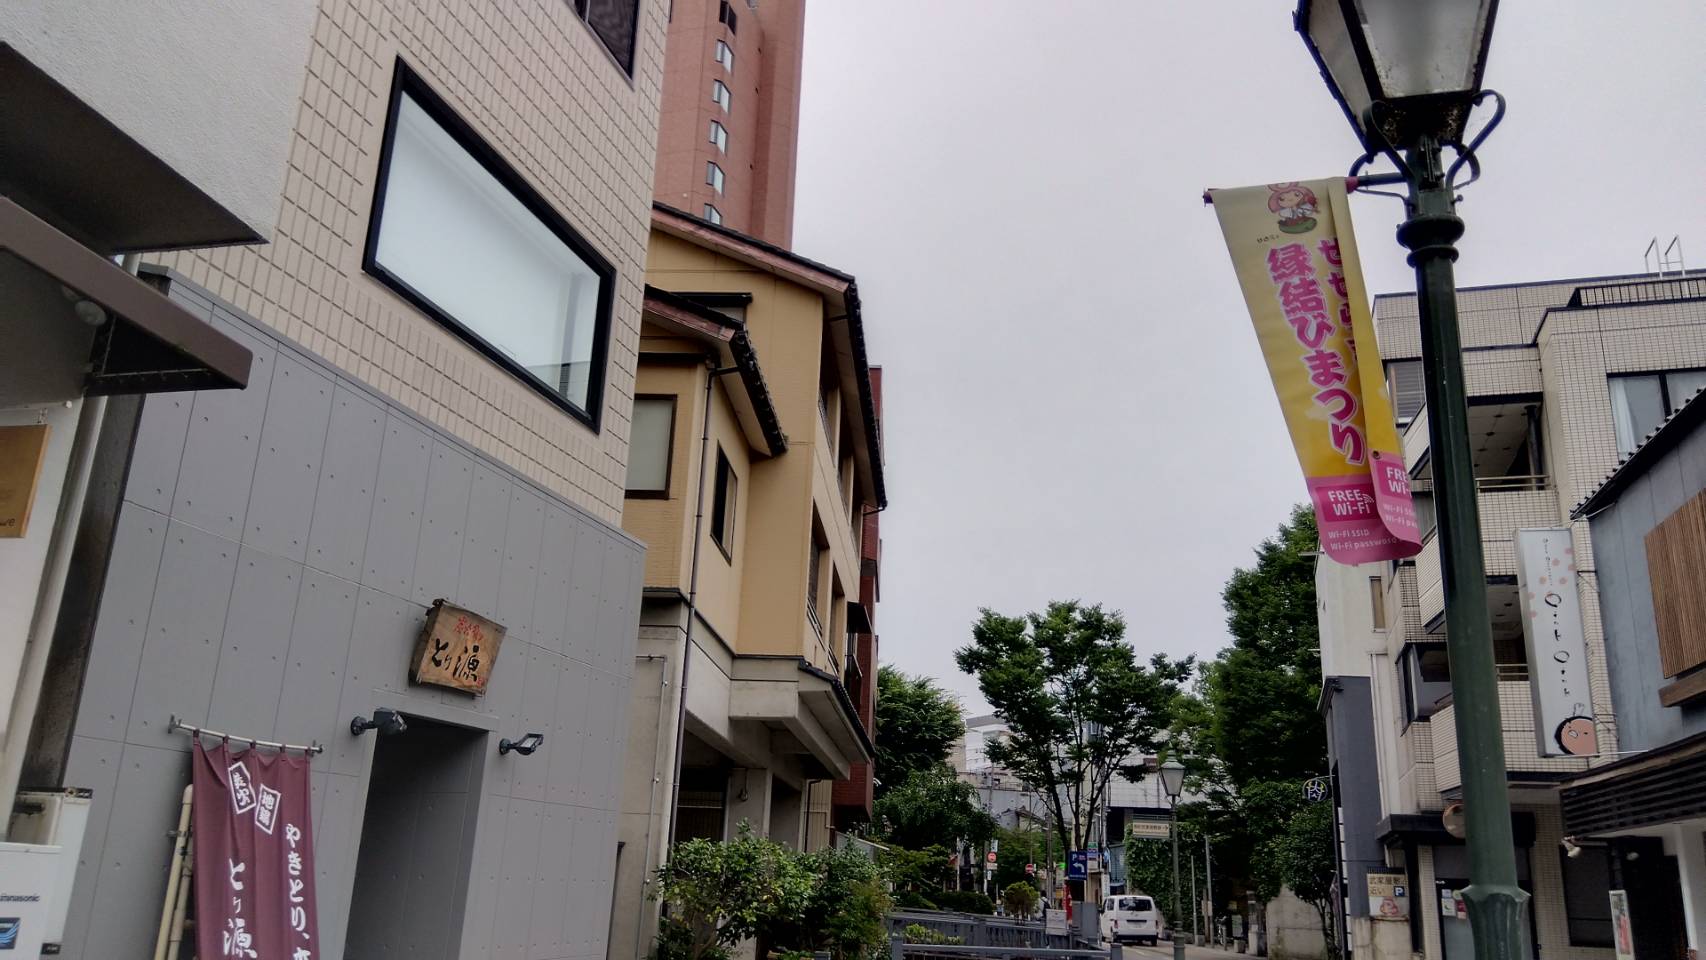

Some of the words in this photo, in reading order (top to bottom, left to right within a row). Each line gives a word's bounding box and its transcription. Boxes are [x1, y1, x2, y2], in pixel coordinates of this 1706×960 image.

[1266, 243, 1365, 464] 縁結びまつり
[1328, 489, 1363, 502] FREE
[1332, 502, 1370, 516] Wi-Fi
[1328, 530, 1350, 539] Wi-Fi
[1331, 541, 1352, 550] Wi-Fi
[1395, 887, 1404, 896] P
[223, 857, 258, 959] とり源
